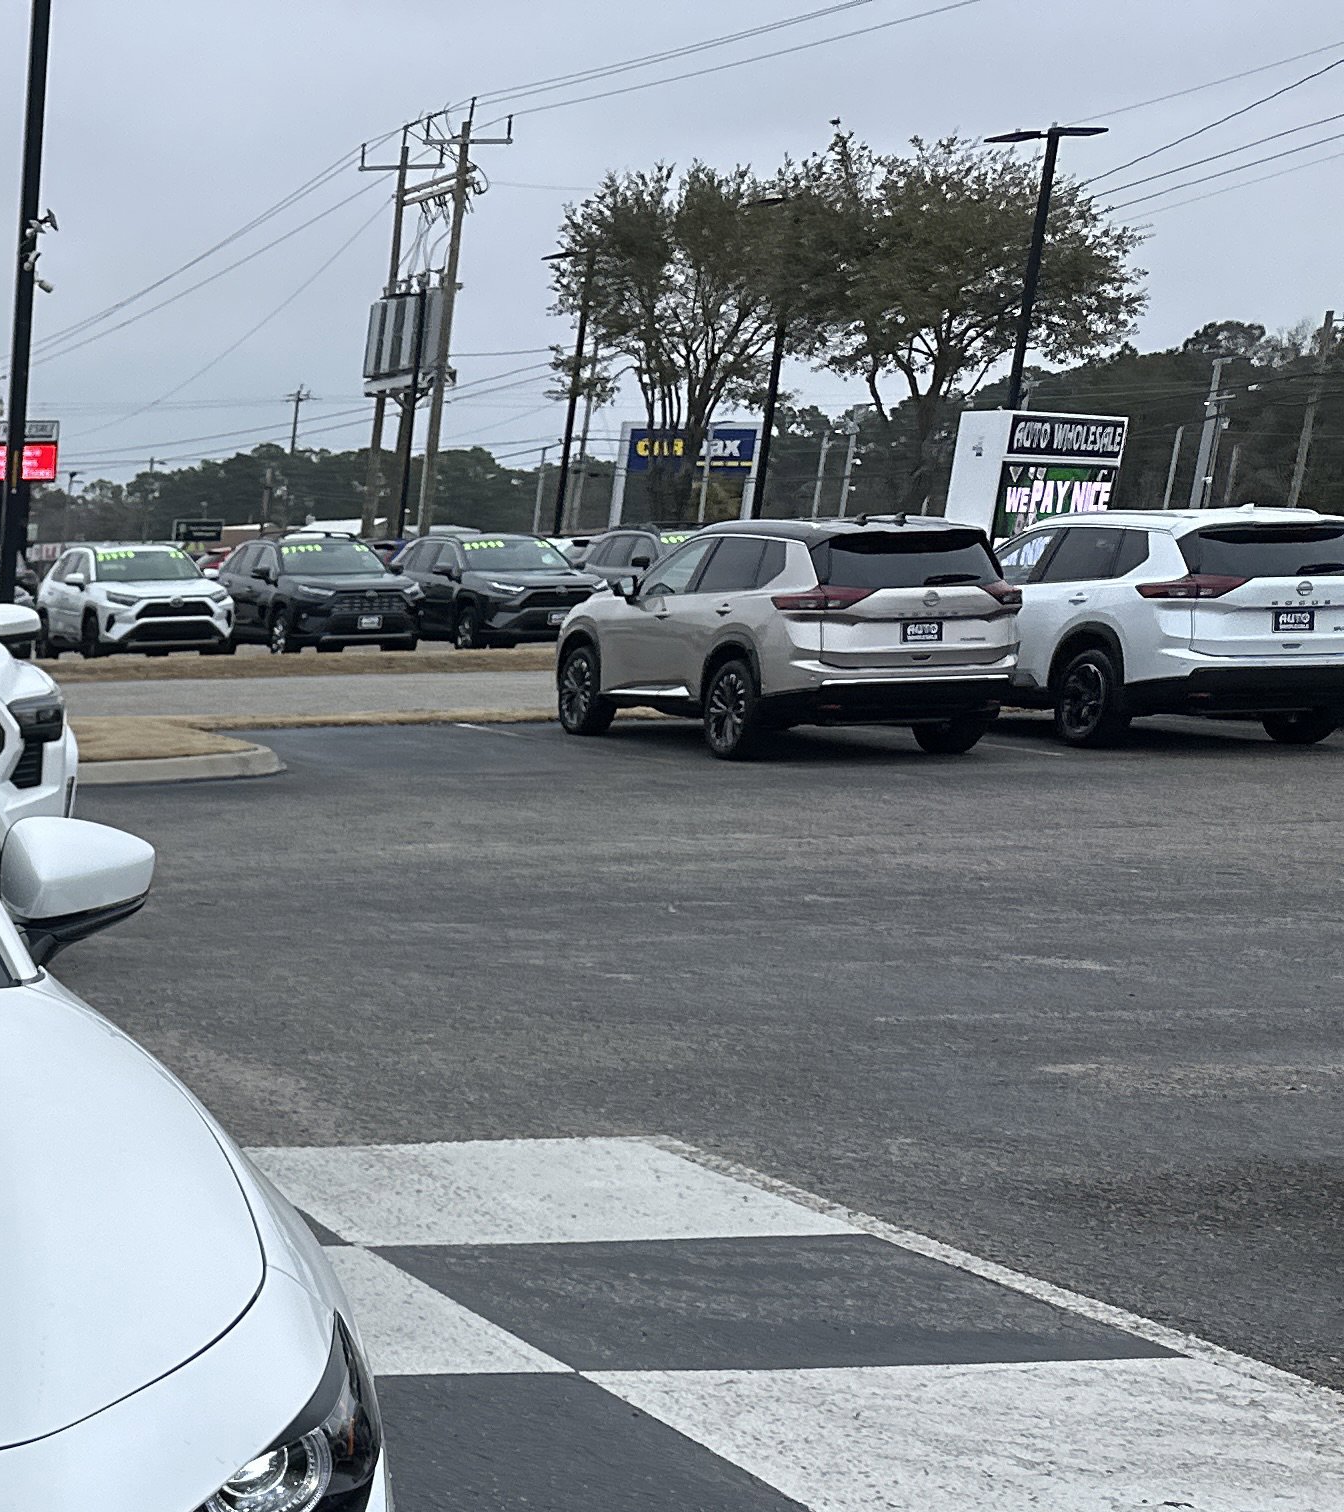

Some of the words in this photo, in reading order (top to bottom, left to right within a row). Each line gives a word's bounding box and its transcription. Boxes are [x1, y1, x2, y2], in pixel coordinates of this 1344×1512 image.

[1013, 421, 1051, 450] AUTO
[1053, 423, 1123, 453] WHOLESALE
[1005, 486, 1031, 513] WE
[1028, 479, 1071, 514] PAY
[1069, 480, 1112, 514] NICE
[1278, 612, 1311, 624] AUTO
[906, 623, 939, 636] AUTO
